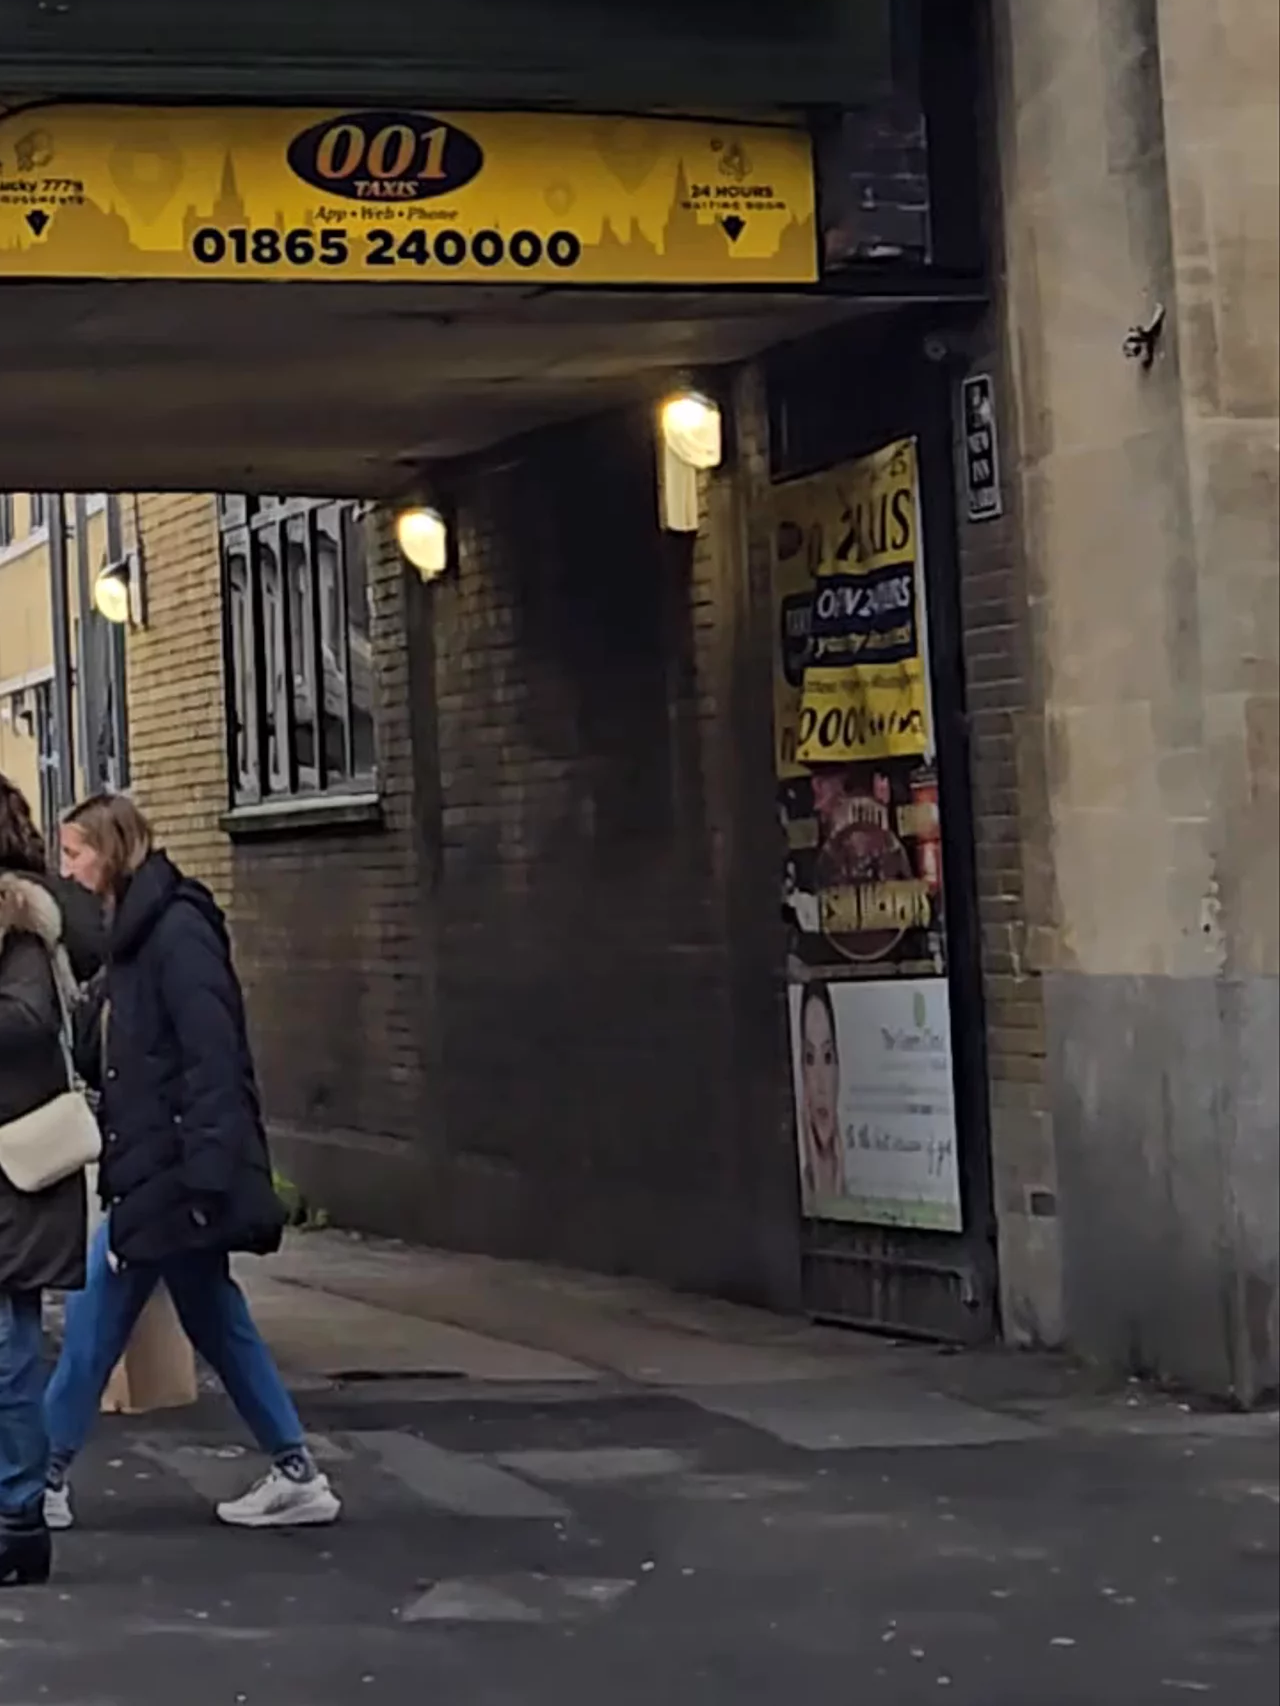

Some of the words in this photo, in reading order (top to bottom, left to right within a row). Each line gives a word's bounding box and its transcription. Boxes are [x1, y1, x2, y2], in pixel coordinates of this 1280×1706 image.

[315, 123, 449, 179] 001
[352, 179, 419, 198] TAXIS
[314, 205, 348, 223] App
[359, 205, 396, 222] Web
[405, 206, 460, 222] Phone
[192, 227, 349, 265] 01865
[365, 229, 582, 268] 240000
